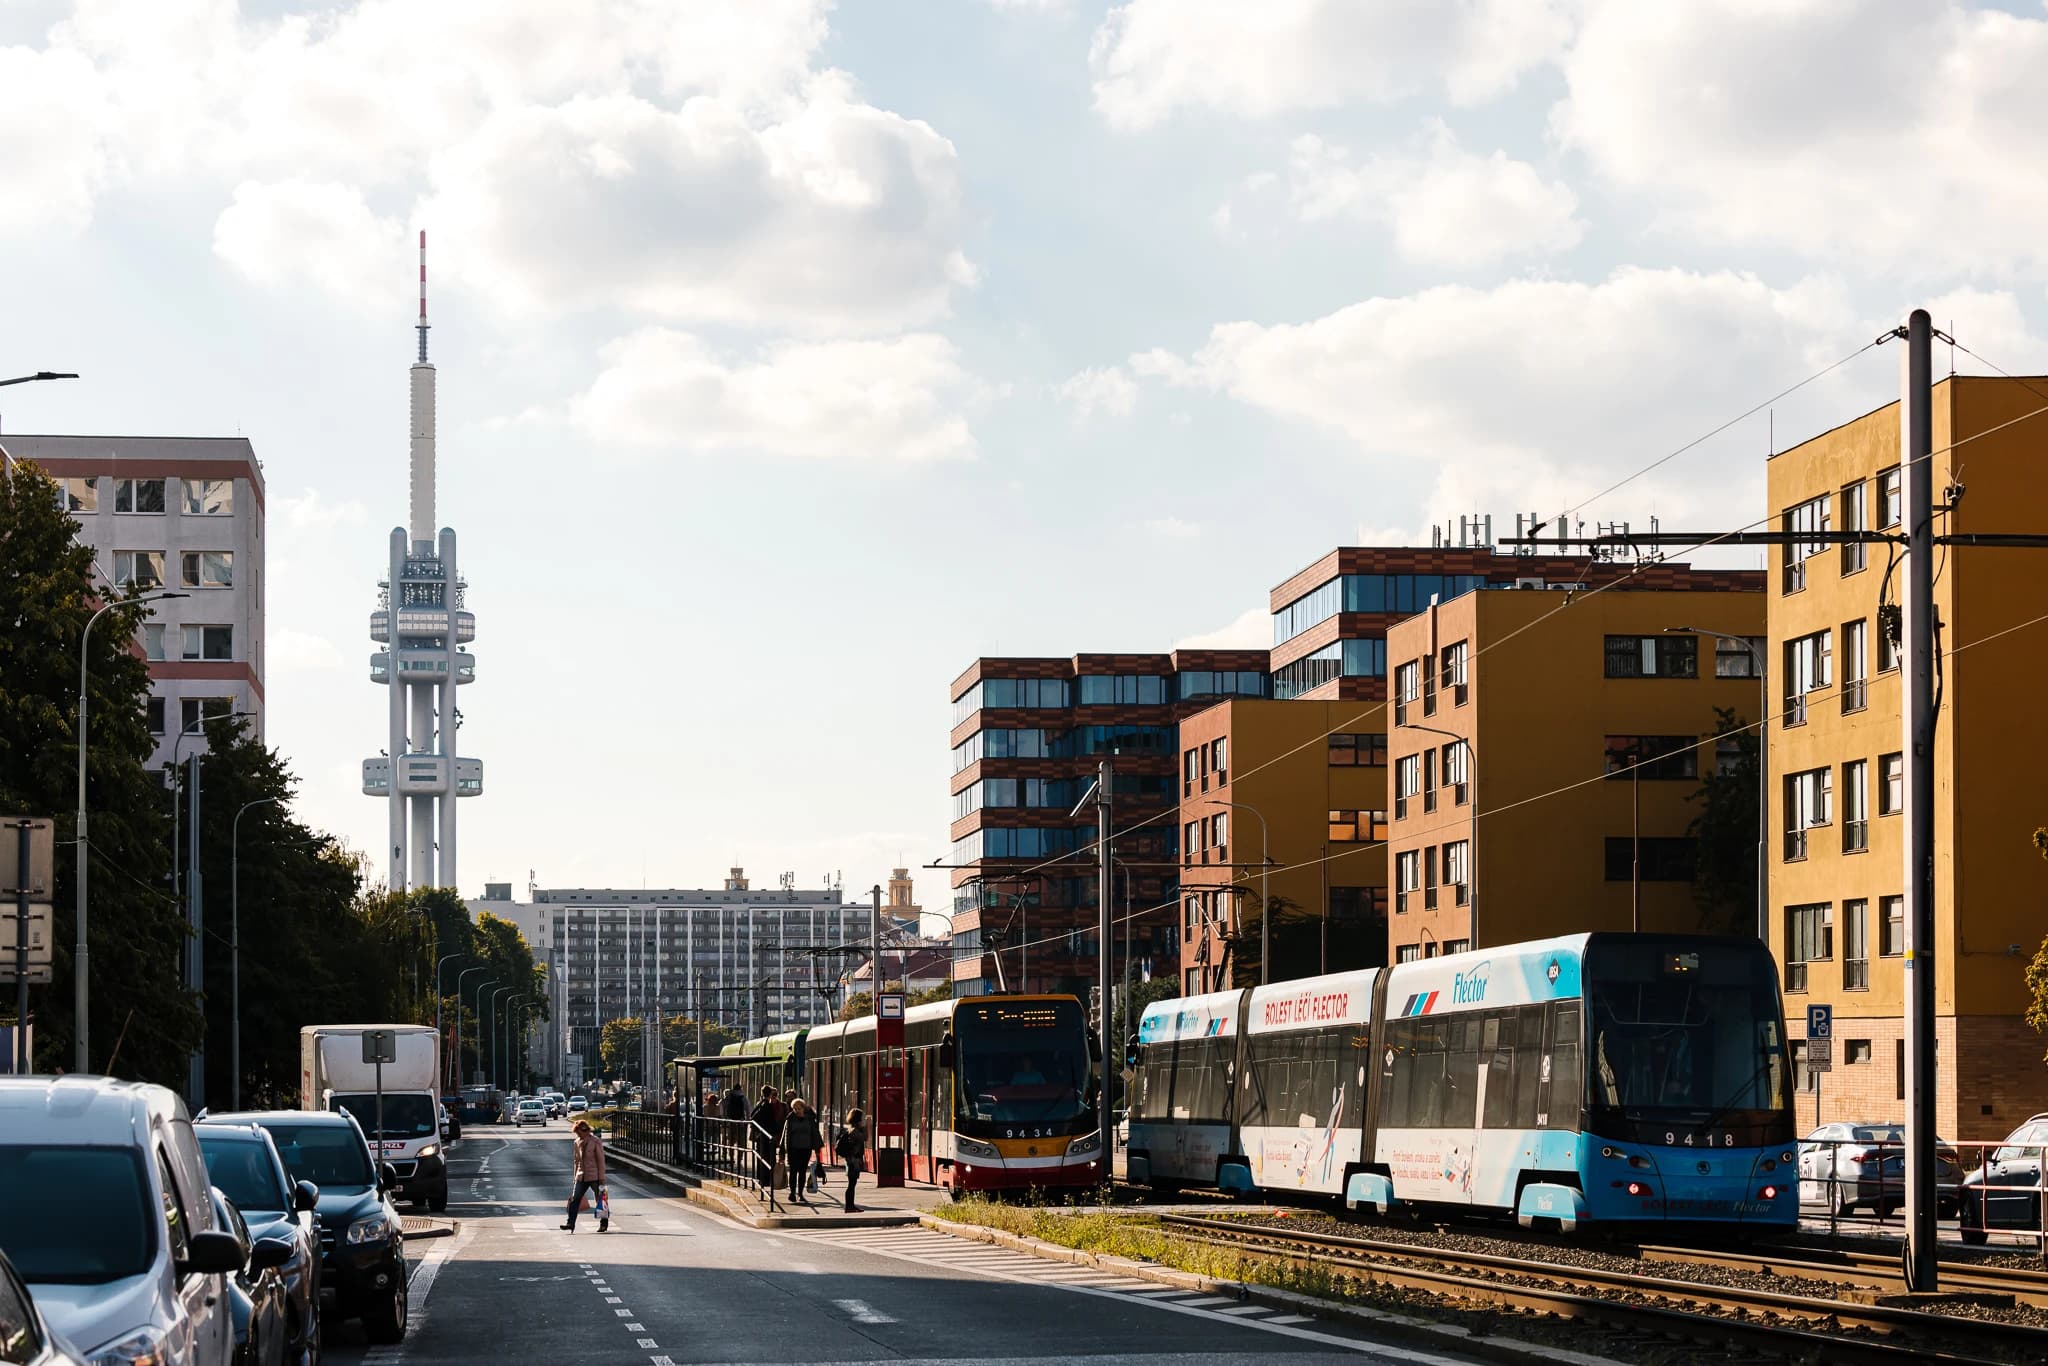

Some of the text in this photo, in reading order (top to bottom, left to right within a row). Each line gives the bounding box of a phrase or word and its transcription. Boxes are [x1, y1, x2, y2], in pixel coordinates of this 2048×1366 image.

[1453, 972, 1488, 1004] Flector
[1265, 991, 1349, 1026] BOLEST LÉČÍ FLECTOR
[1812, 1008, 1827, 1029] P
[1006, 1129, 1053, 1139] 9434
[1665, 1132, 1734, 1147] 9418
